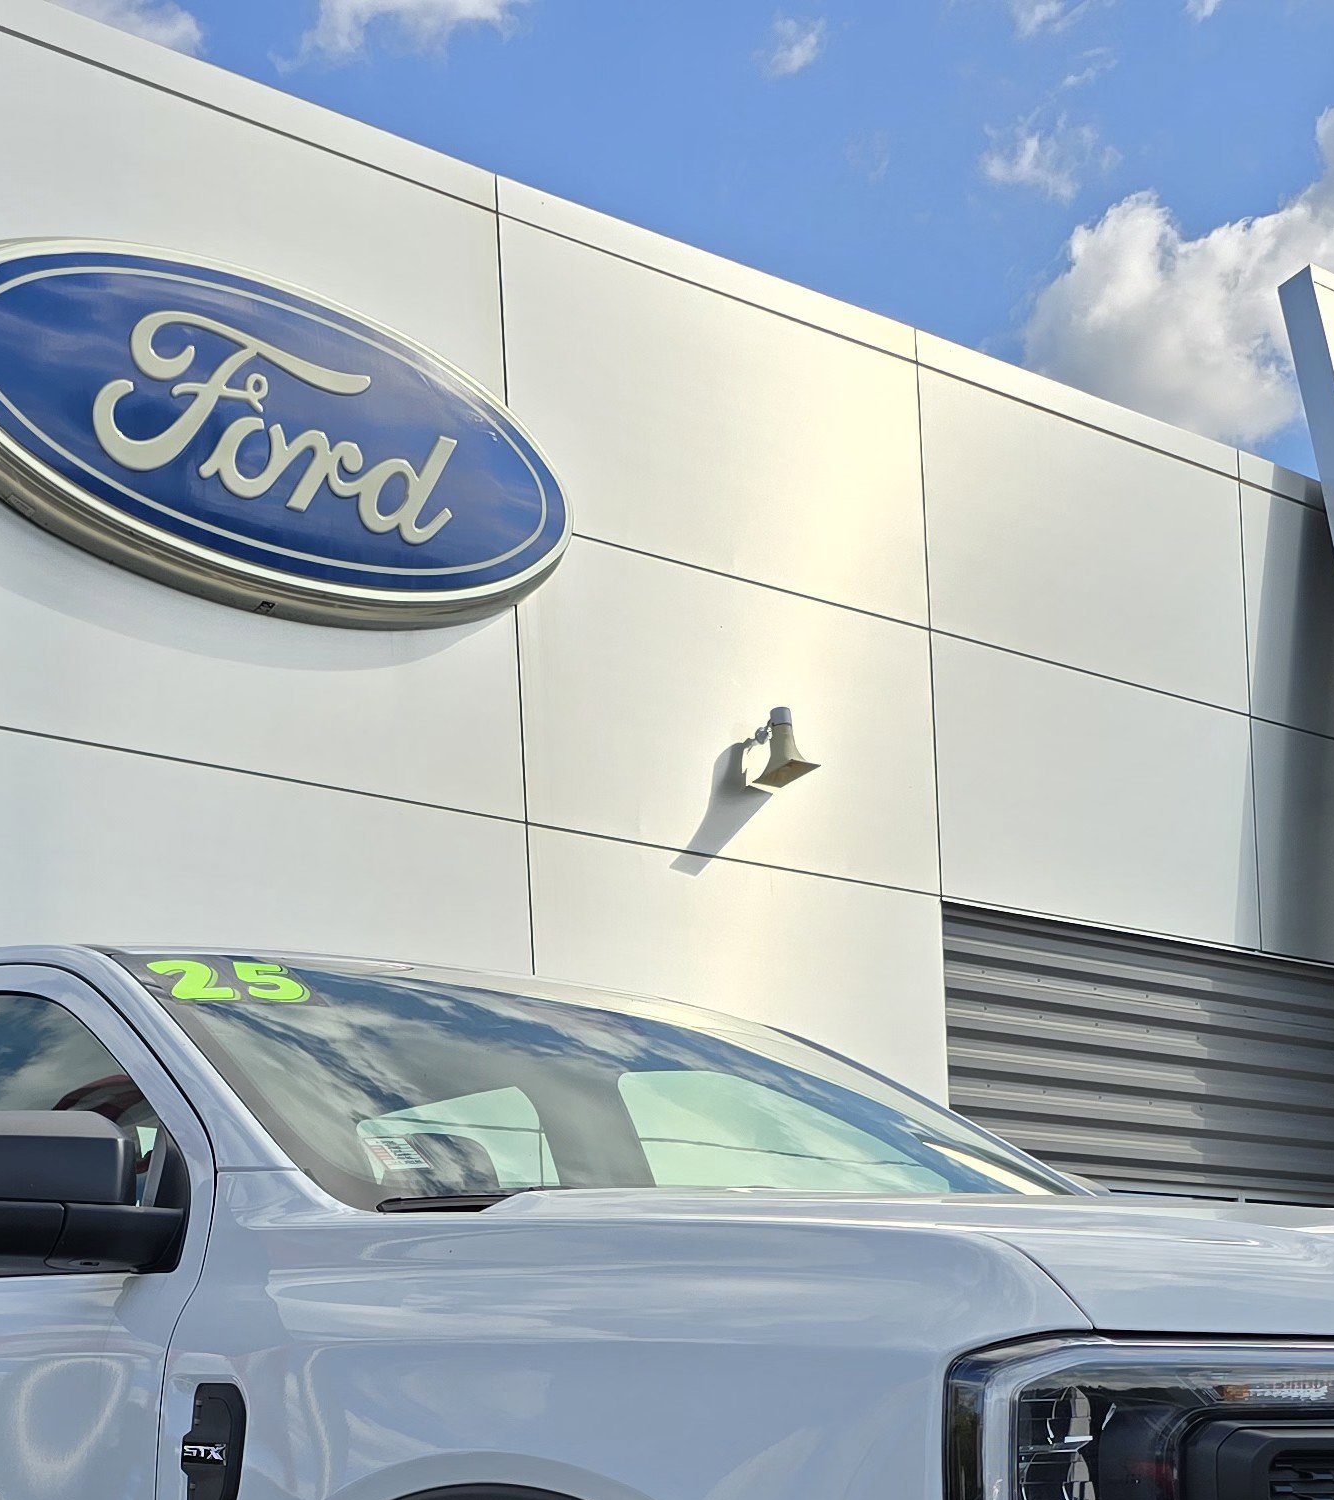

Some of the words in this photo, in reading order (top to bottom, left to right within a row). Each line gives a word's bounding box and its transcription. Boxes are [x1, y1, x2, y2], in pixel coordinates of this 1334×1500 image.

[92, 310, 458, 546] Ford
[147, 959, 311, 1003] 25
[183, 1443, 226, 1461] STX
